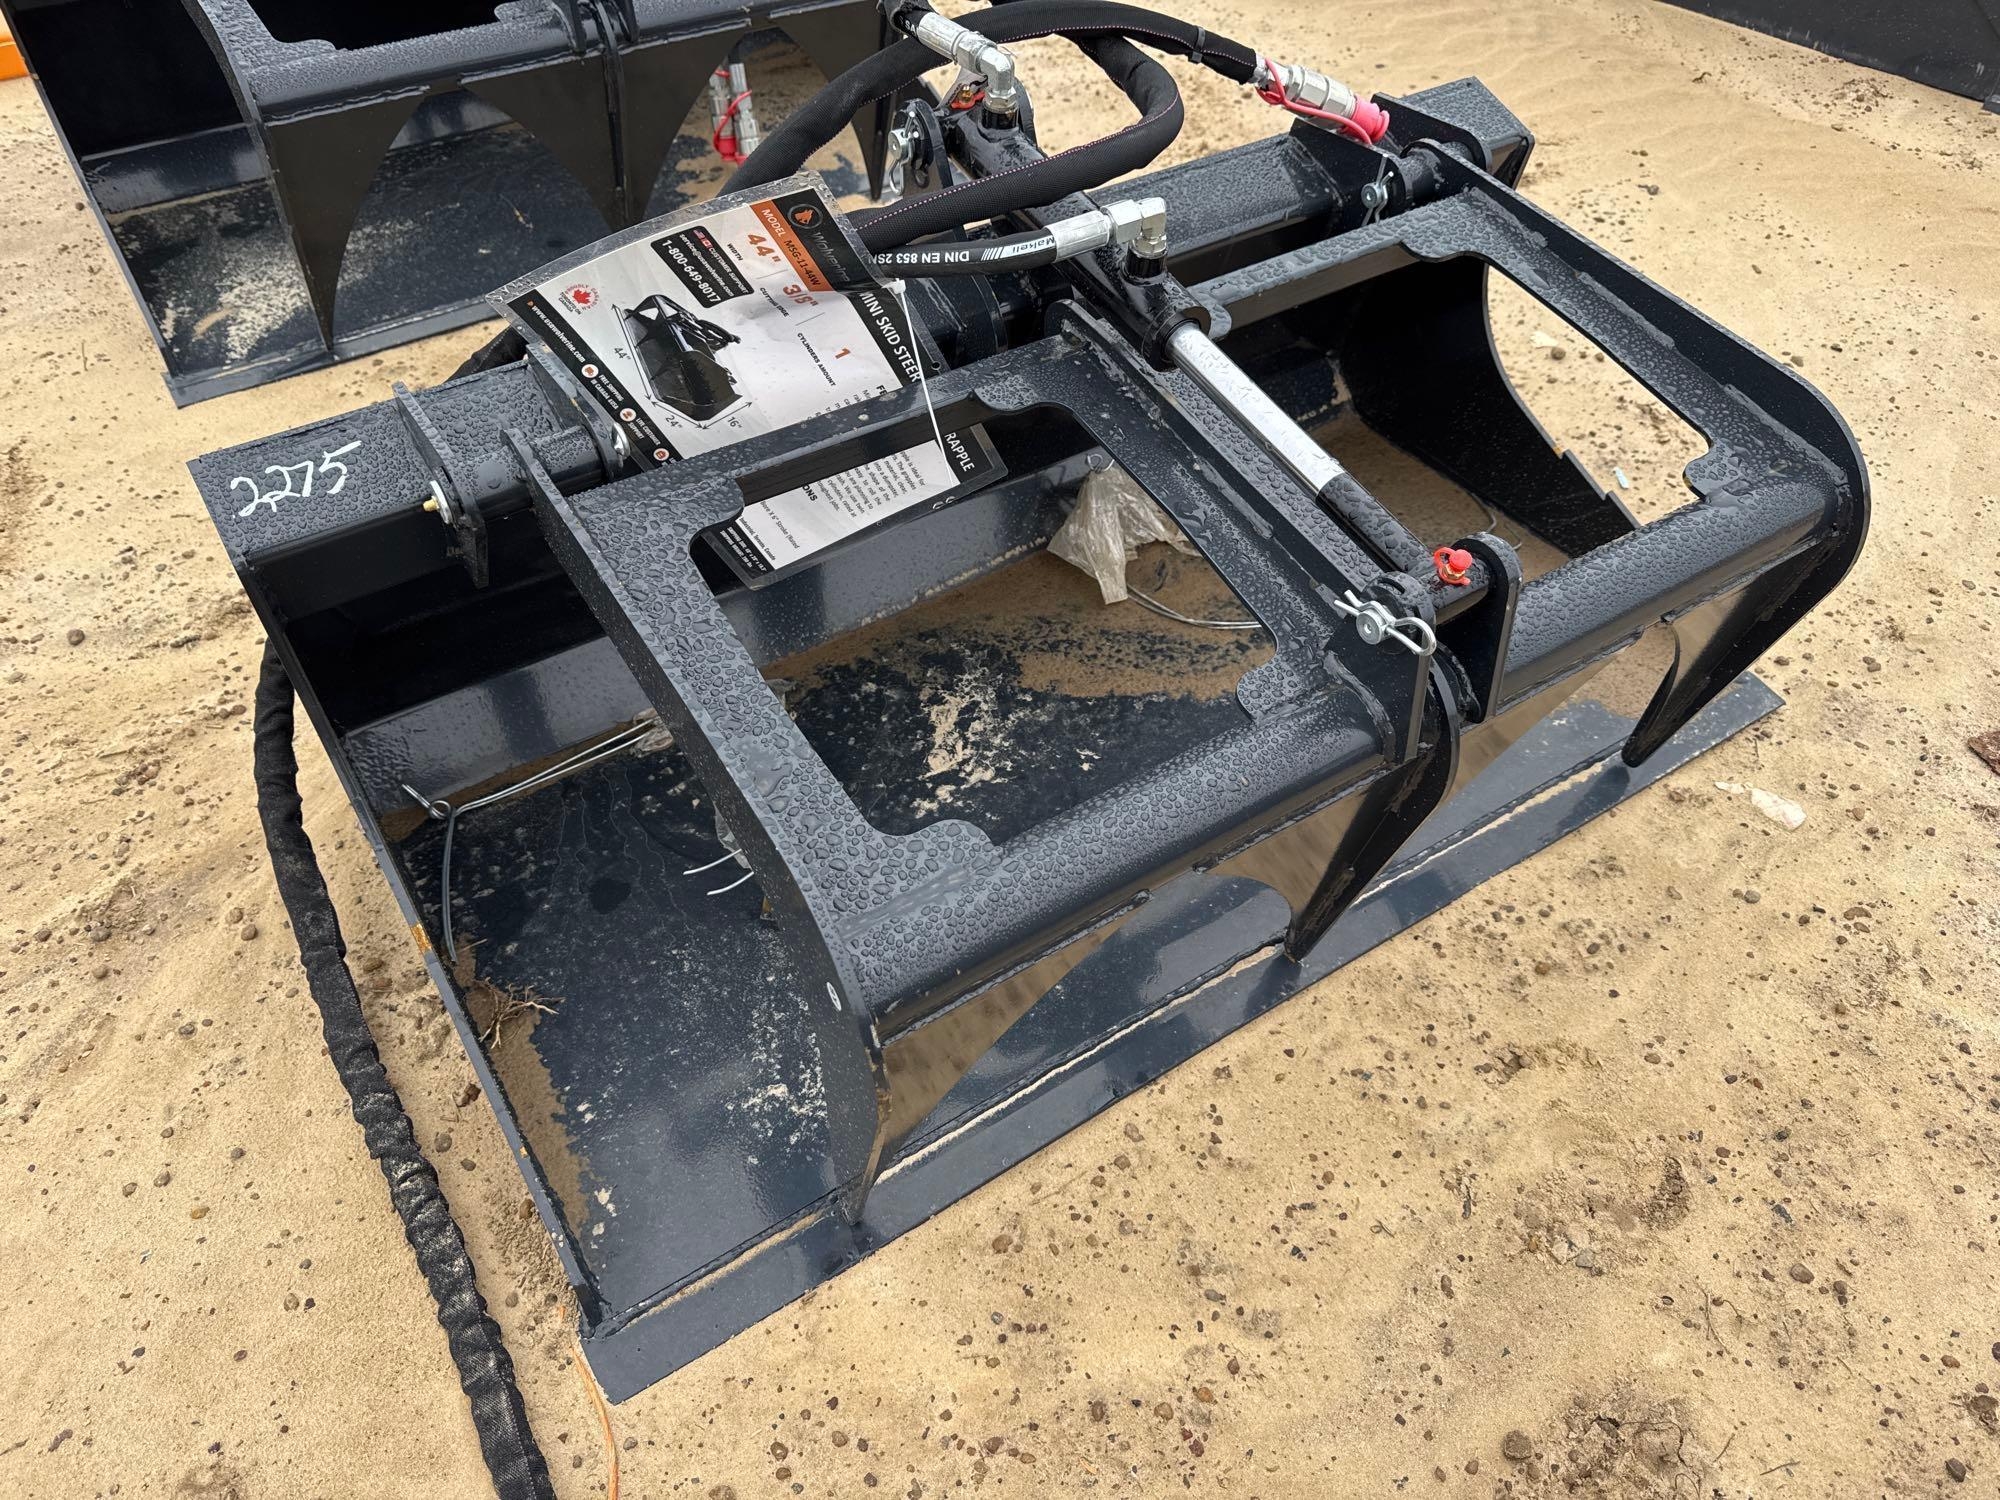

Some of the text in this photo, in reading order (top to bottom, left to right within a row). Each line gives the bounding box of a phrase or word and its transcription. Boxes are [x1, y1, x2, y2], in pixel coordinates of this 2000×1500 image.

[727, 243, 743, 261] WIDTH
[748, 234, 781, 262] 44"
[761, 208, 821, 286] MODEL MSG-11-44W
[812, 232, 851, 282] Wolverine
[868, 250, 970, 265] DIN EN 853 2SN
[662, 240, 721, 302] 1-800-649-8017
[680, 233, 734, 297] service@usawolverine.com
[708, 247, 749, 294] CUSTOMER SUPPORT
[558, 297, 573, 312] CANADA
[760, 287, 789, 317] CUTTING EDGE
[532, 305, 586, 363] www.usawolverine.com
[860, 293, 921, 383] MINI SKID STEER
[614, 347, 632, 360] 44"
[797, 332, 837, 387] CYLINDERS AMOUNT
[834, 347, 851, 360] 1
[598, 374, 625, 402] FREE SHIPPING
[628, 421, 645, 439] SUPPORT
[643, 424, 661, 446] CUSTOMER
[665, 415, 683, 428] 24"
[728, 417, 743, 429] 16"
[944, 432, 975, 472] RAPPLE
[230, 440, 362, 517] 2275
[901, 471, 916, 490] grapples
[854, 485, 870, 505] planning
